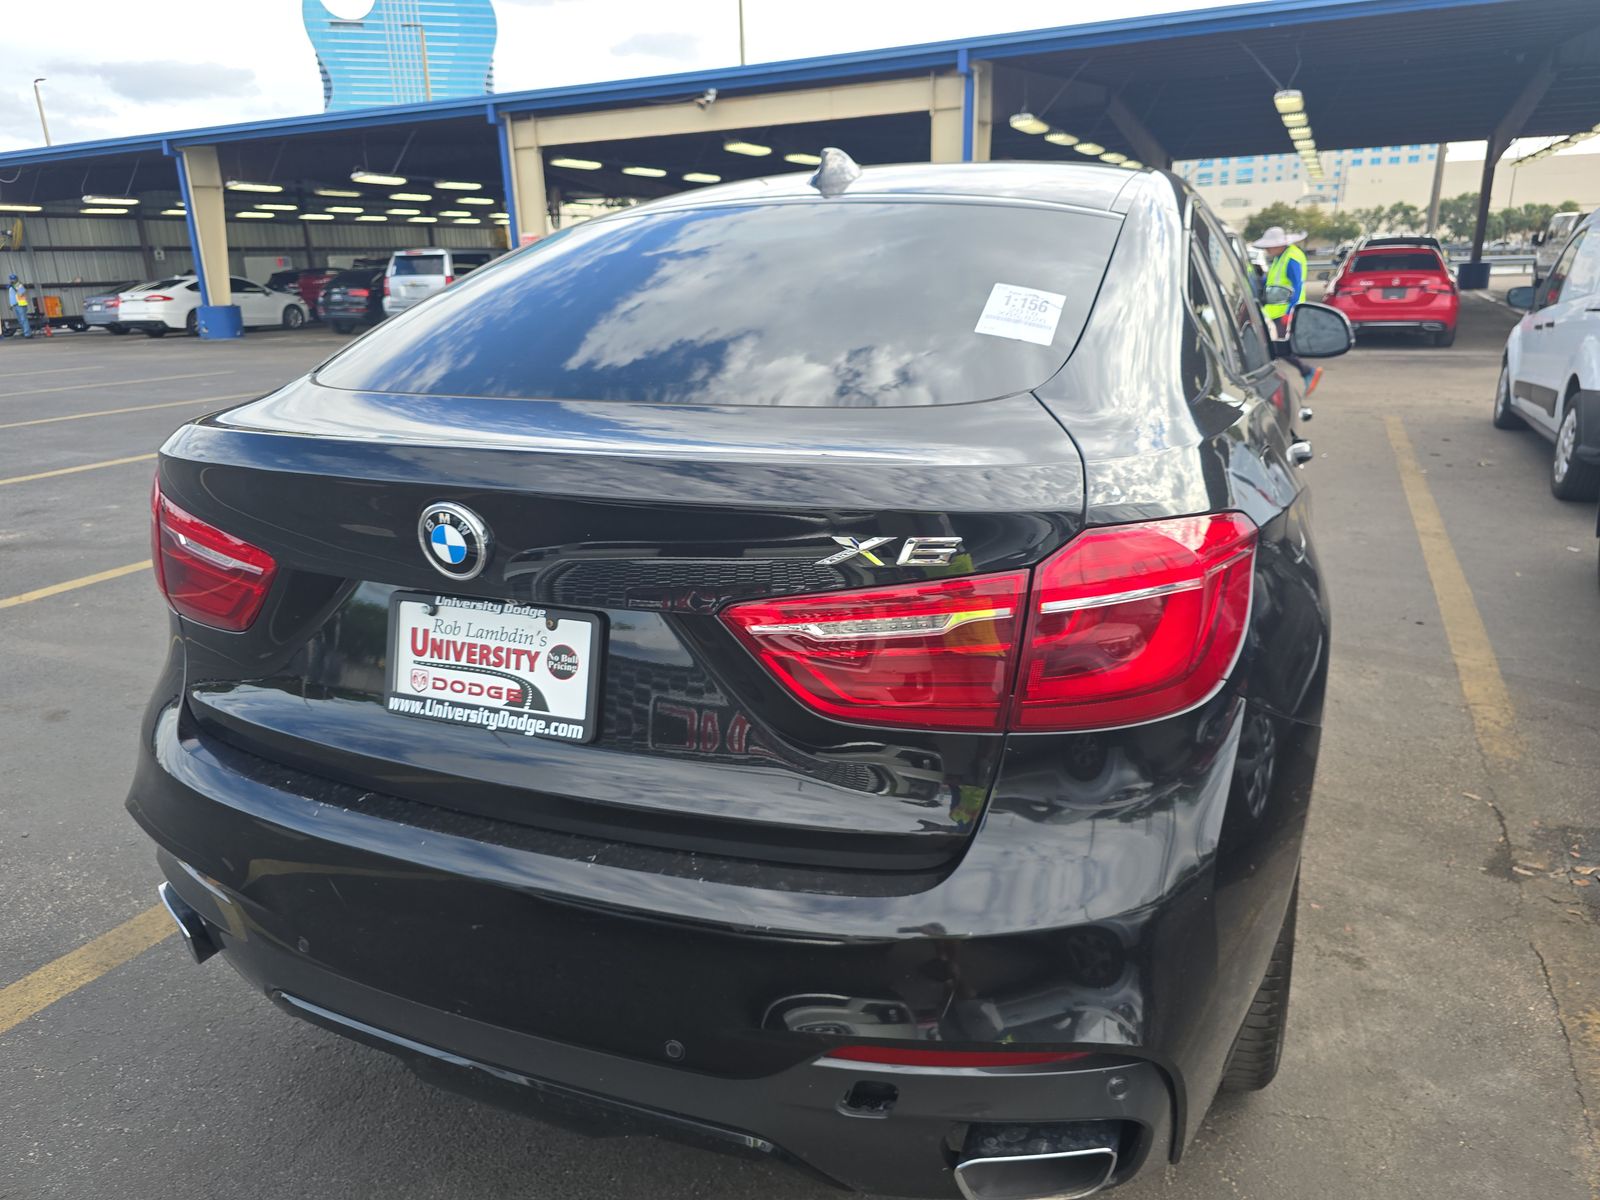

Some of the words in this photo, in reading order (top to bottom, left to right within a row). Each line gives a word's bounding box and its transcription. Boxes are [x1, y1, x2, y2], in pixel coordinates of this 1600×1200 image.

[425, 512, 472, 536] BMW
[814, 536, 963, 566] X6
[434, 595, 502, 613] University
[504, 604, 547, 618] Dodge
[432, 618, 461, 636] Rob
[465, 622, 548, 648] Lambdin's
[410, 627, 542, 673] UNIVERSITY
[548, 660, 577, 674] Pricing
[431, 677, 523, 703] DODGE
[388, 696, 584, 740] www.UniversityDodge.com
